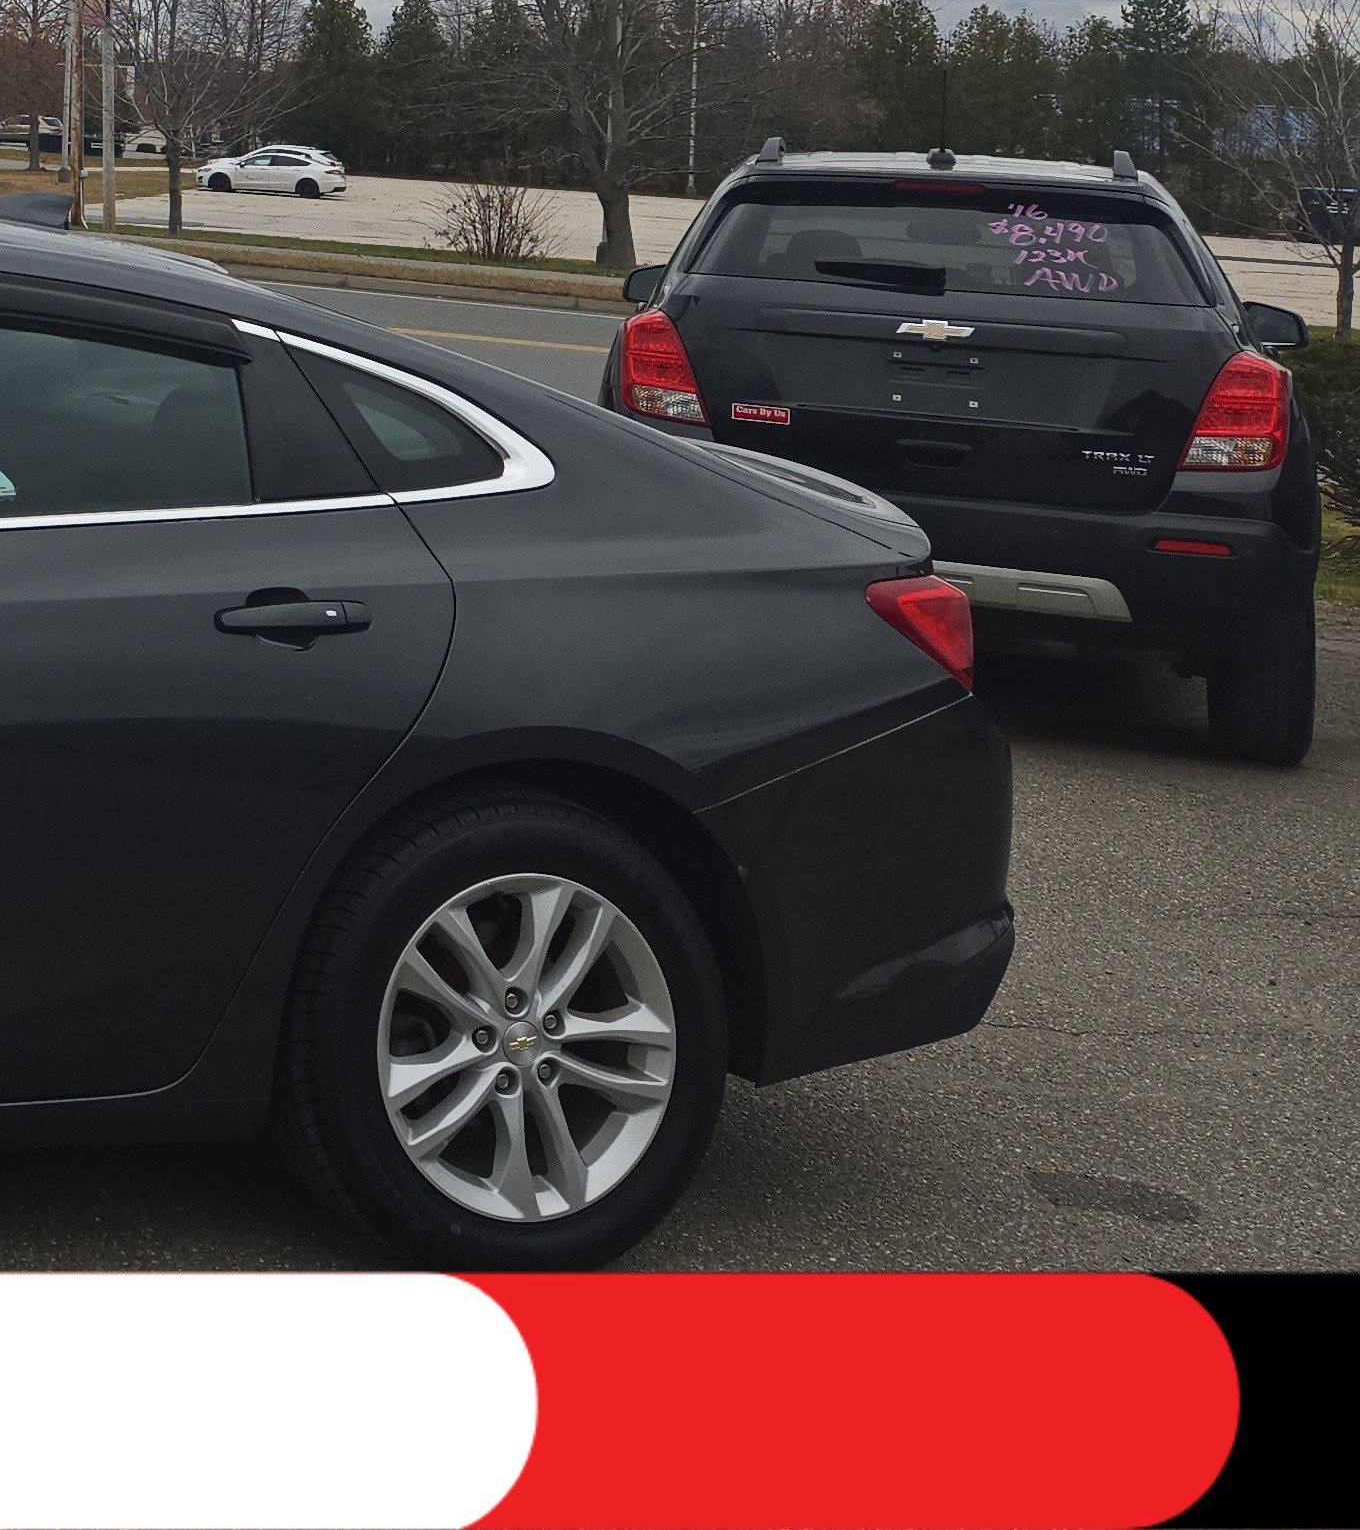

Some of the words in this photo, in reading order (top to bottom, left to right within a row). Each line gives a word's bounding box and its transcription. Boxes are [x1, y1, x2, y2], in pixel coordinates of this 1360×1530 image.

[1024, 267, 1118, 293] AWD
[736, 405, 758, 415] Cars
[760, 407, 773, 417] By
[774, 409, 786, 418] Us
[1081, 450, 1131, 461] TRAX
[1138, 454, 1155, 463] LT
[1113, 466, 1148, 476] AWD
